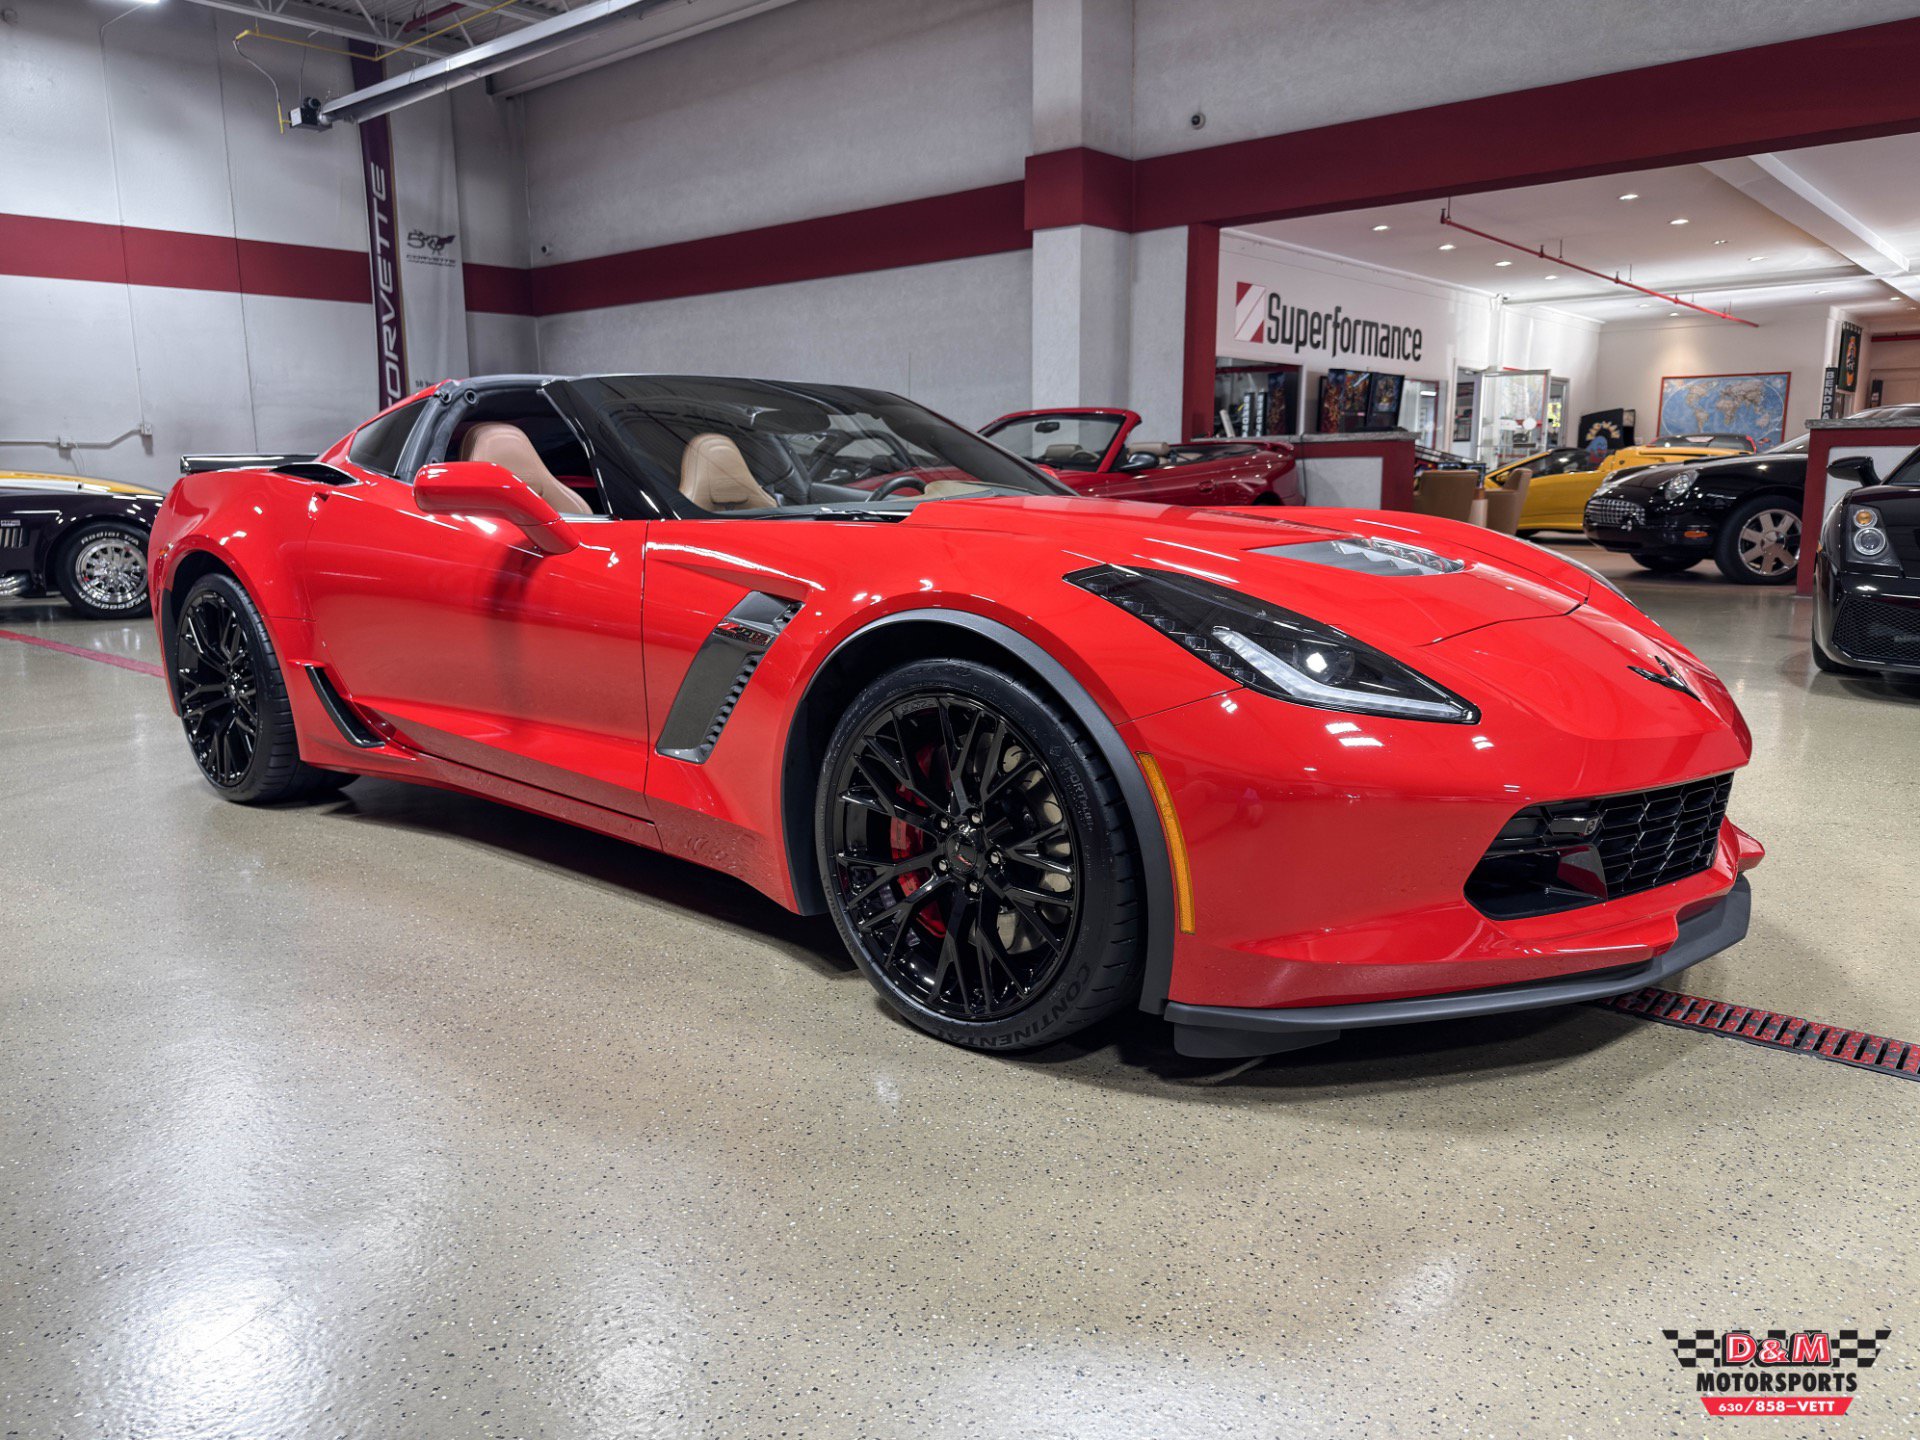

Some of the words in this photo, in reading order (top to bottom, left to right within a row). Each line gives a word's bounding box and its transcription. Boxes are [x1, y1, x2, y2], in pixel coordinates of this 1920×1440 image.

[370, 161, 402, 405] ORVETTE
[1267, 293, 1422, 362] Superformance
[929, 963, 1091, 1048] CONTINENTAL
